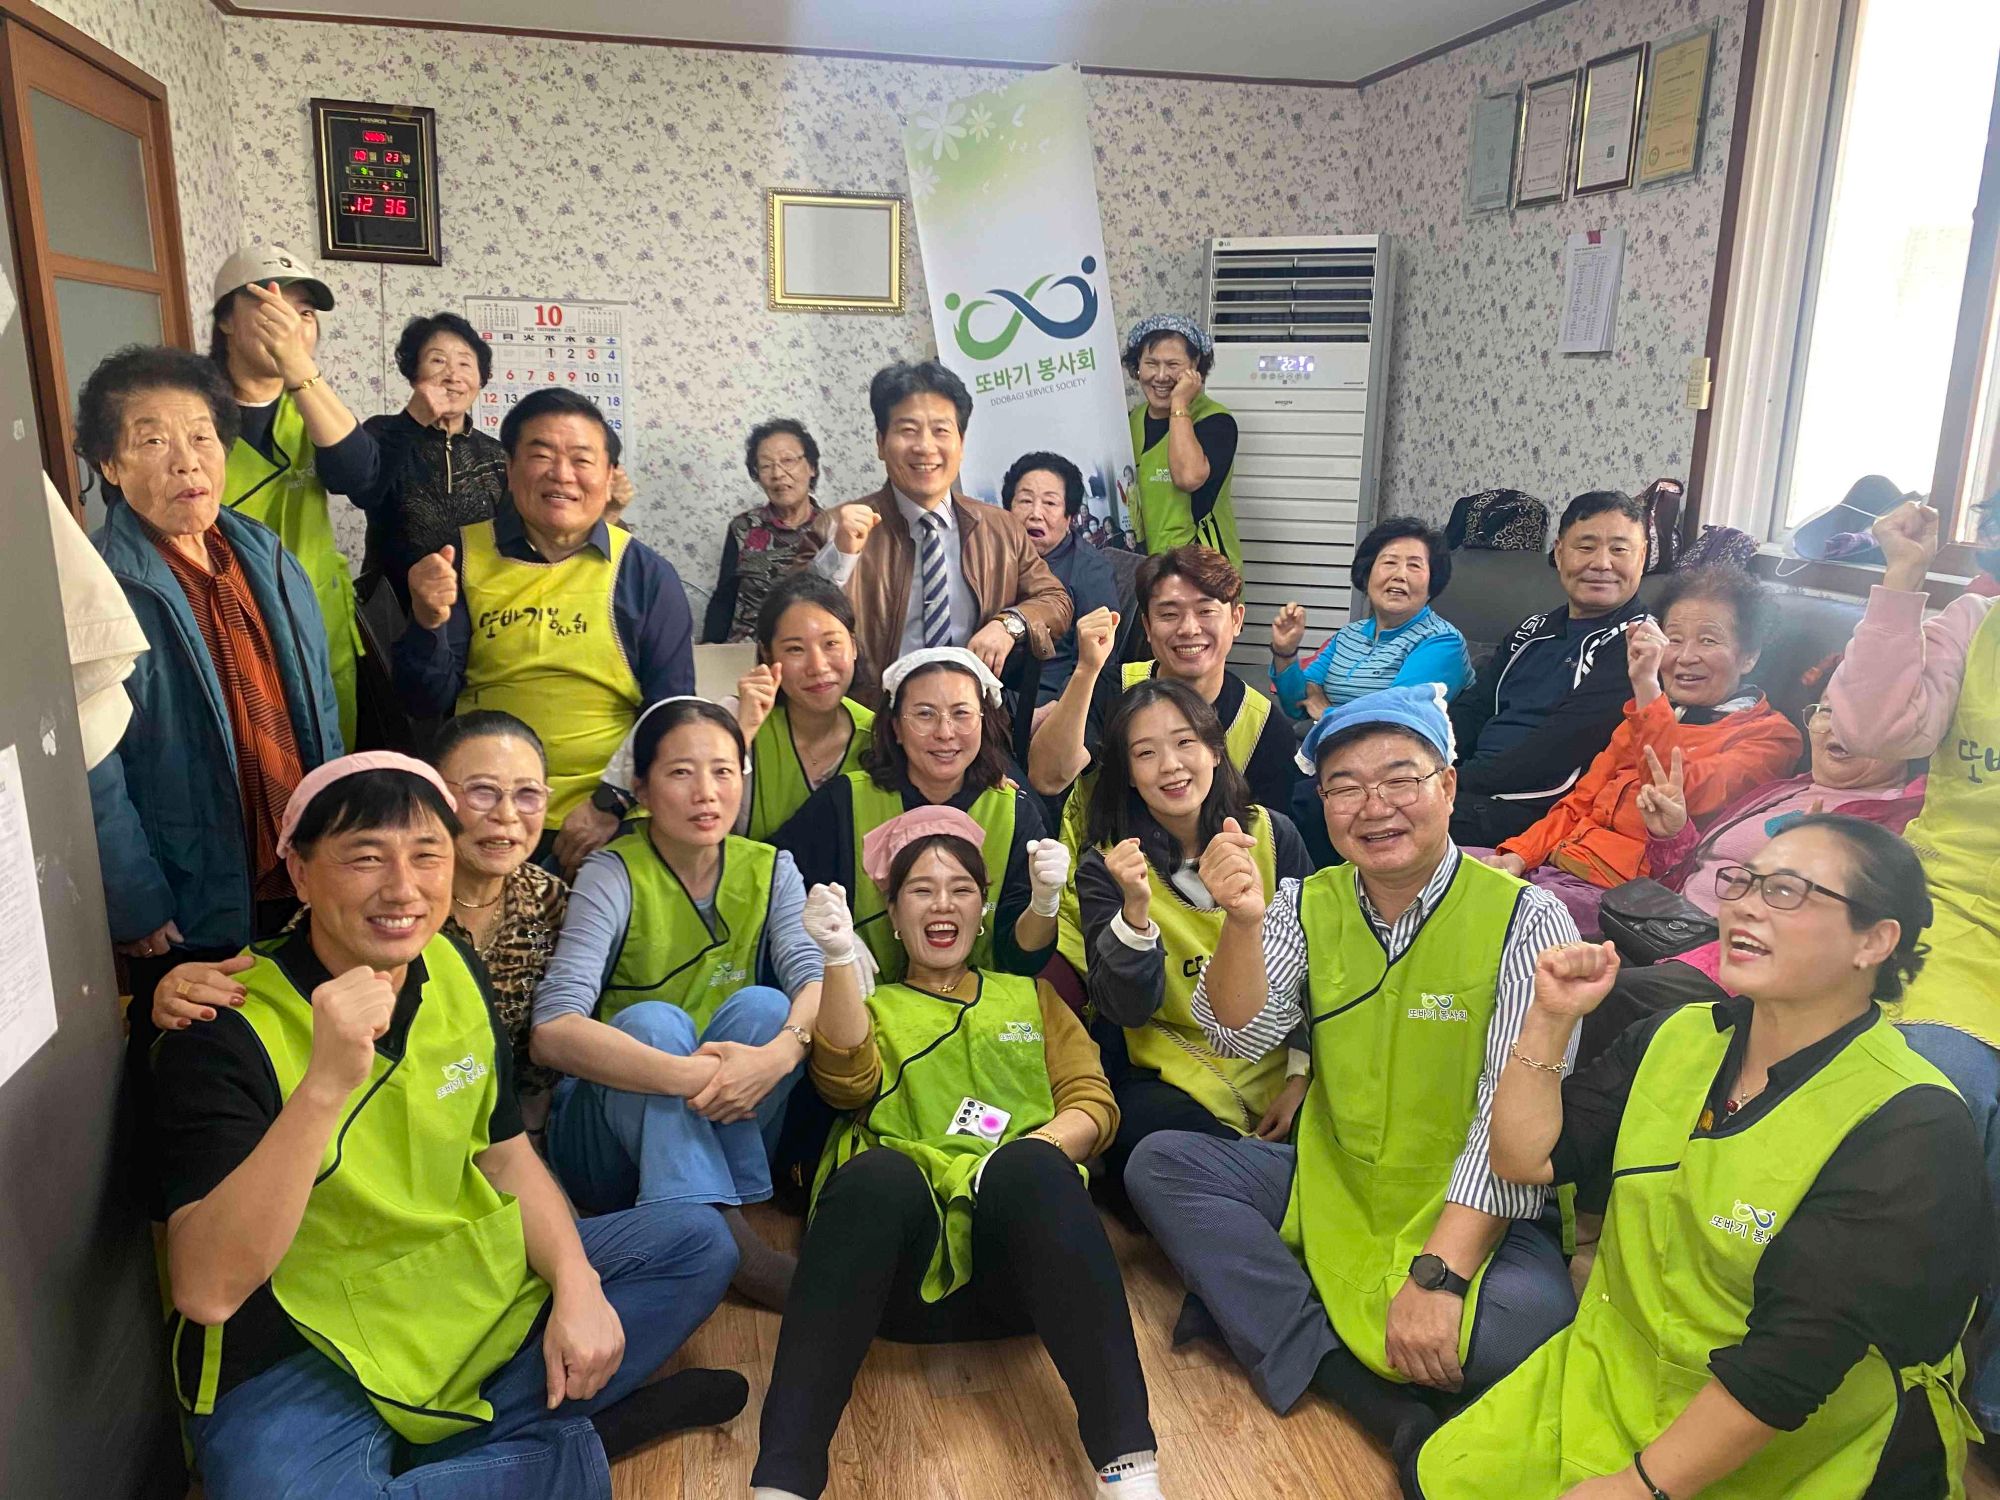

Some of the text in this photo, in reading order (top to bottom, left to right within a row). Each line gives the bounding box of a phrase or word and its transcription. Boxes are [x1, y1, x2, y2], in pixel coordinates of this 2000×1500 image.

[386, 153, 399, 162] 23
[357, 197, 406, 215] 12 36
[534, 304, 563, 326] 10
[523, 334, 535, 342] 火
[567, 349, 575, 359] 2
[587, 349, 595, 359] 3
[608, 350, 616, 360] 4
[506, 370, 514, 380] 6
[527, 370, 534, 380] 7
[548, 371, 555, 381] 8
[567, 371, 576, 382] 9
[585, 372, 600, 382] 10
[607, 373, 619, 383] 11
[975, 347, 1096, 394] 또바기 봉사회
[990, 377, 1087, 406] DDOBAGI SERVICE SOCIETY
[483, 393, 498, 403] 12
[504, 393, 518, 404] 13
[607, 396, 620, 407] 18
[484, 416, 498, 426] 19
[479, 607, 587, 639] 또바기 봉사회
[1408, 1008, 1468, 1022] 또바기 봉사회
[1710, 1215, 1748, 1239] 또바기
